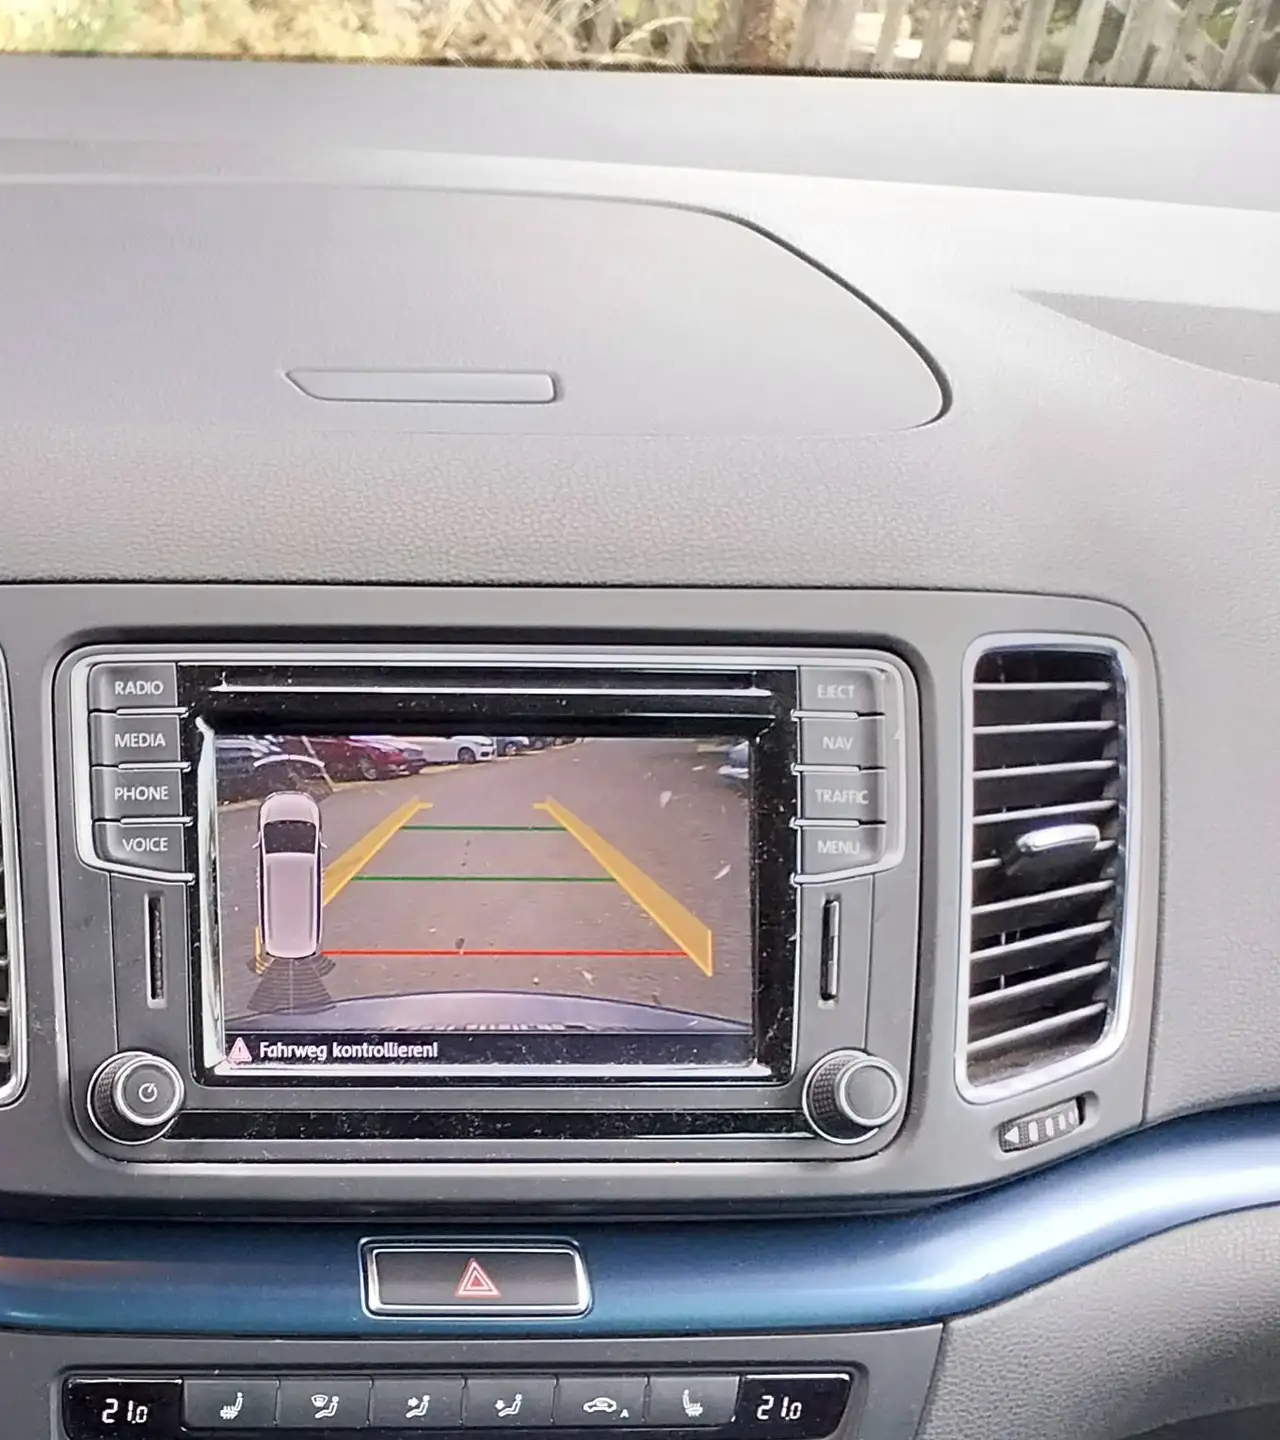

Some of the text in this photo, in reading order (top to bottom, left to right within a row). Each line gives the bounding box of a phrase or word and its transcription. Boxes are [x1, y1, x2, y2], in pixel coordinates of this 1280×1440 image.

[114, 681, 164, 696] RADIO
[817, 684, 855, 699] EJECT
[114, 733, 166, 748] MEDIA
[823, 736, 854, 750] NAV
[114, 786, 169, 801] PHONE
[815, 789, 869, 804] TRAFFIC
[122, 837, 168, 852] VOICE
[817, 840, 860, 855] MENU
[259, 1041, 438, 1061] Fahrweg kontrollieren!
